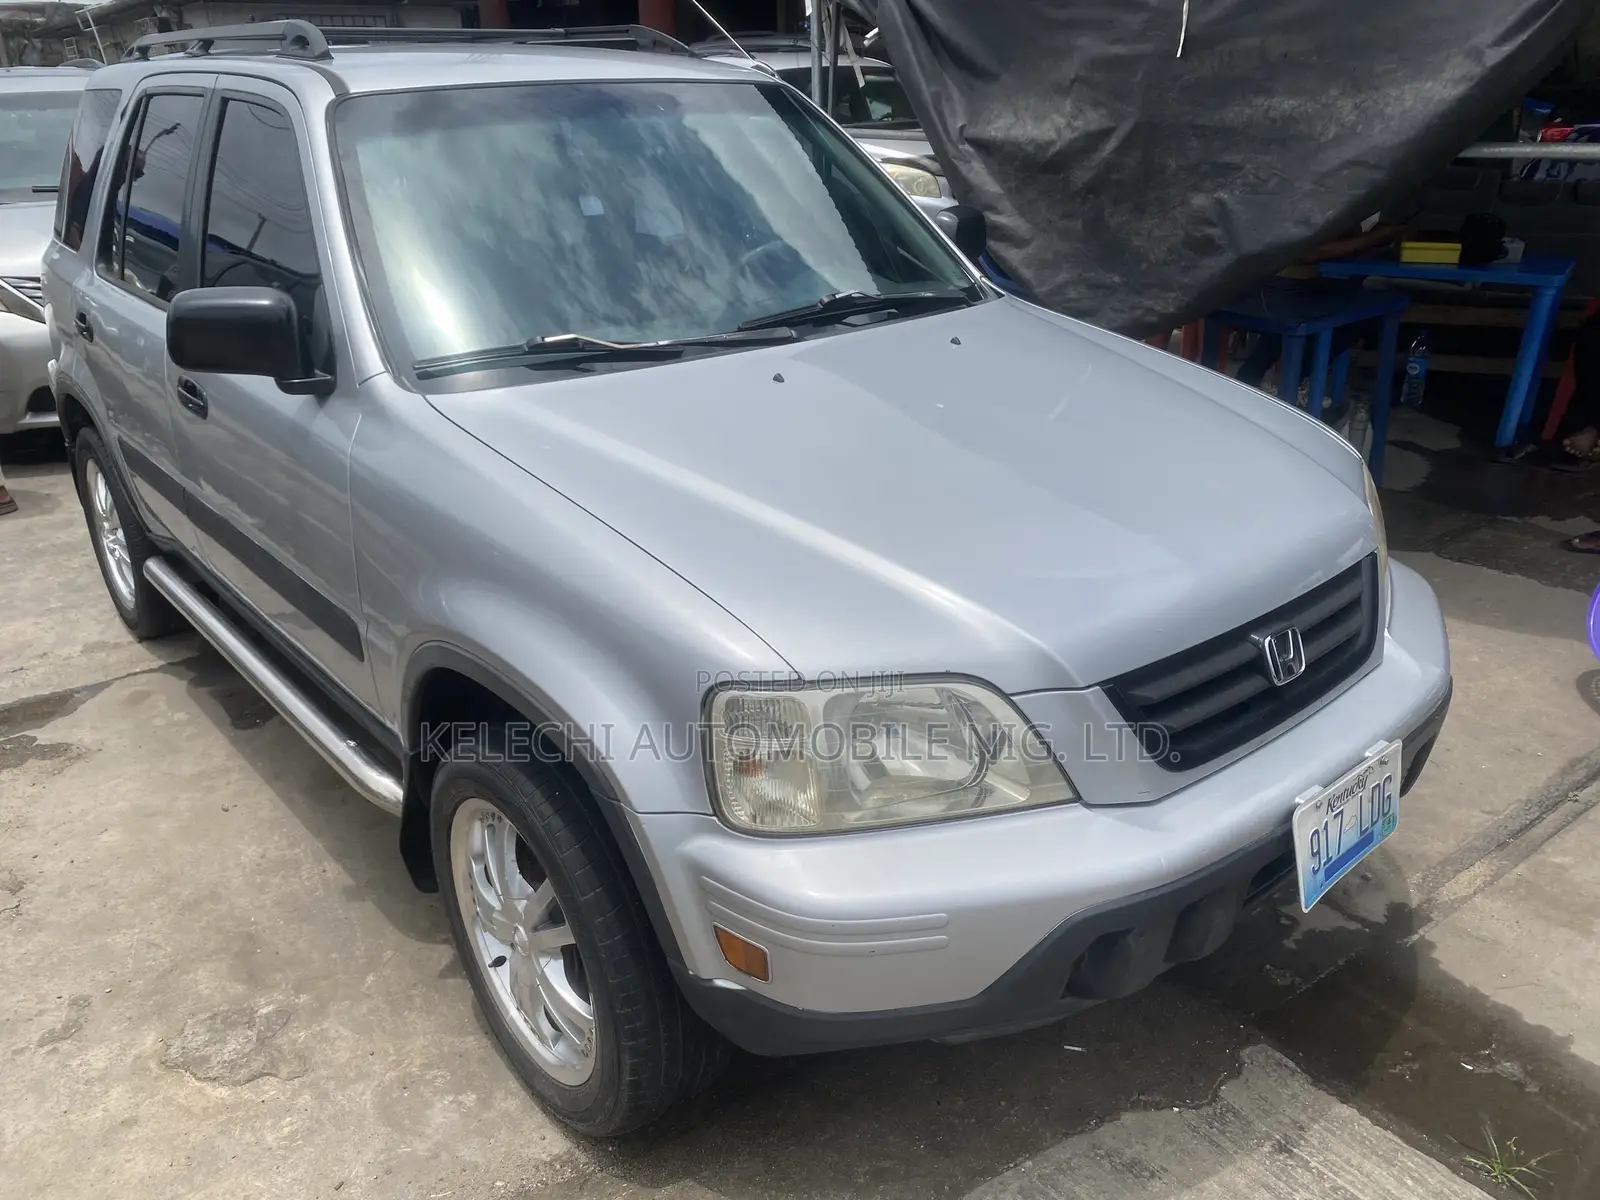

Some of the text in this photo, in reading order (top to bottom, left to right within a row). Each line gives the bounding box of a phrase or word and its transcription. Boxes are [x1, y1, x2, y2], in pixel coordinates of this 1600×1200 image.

[1309, 773, 1392, 875] 917 LDG
[1326, 773, 1369, 815] Kentucky
